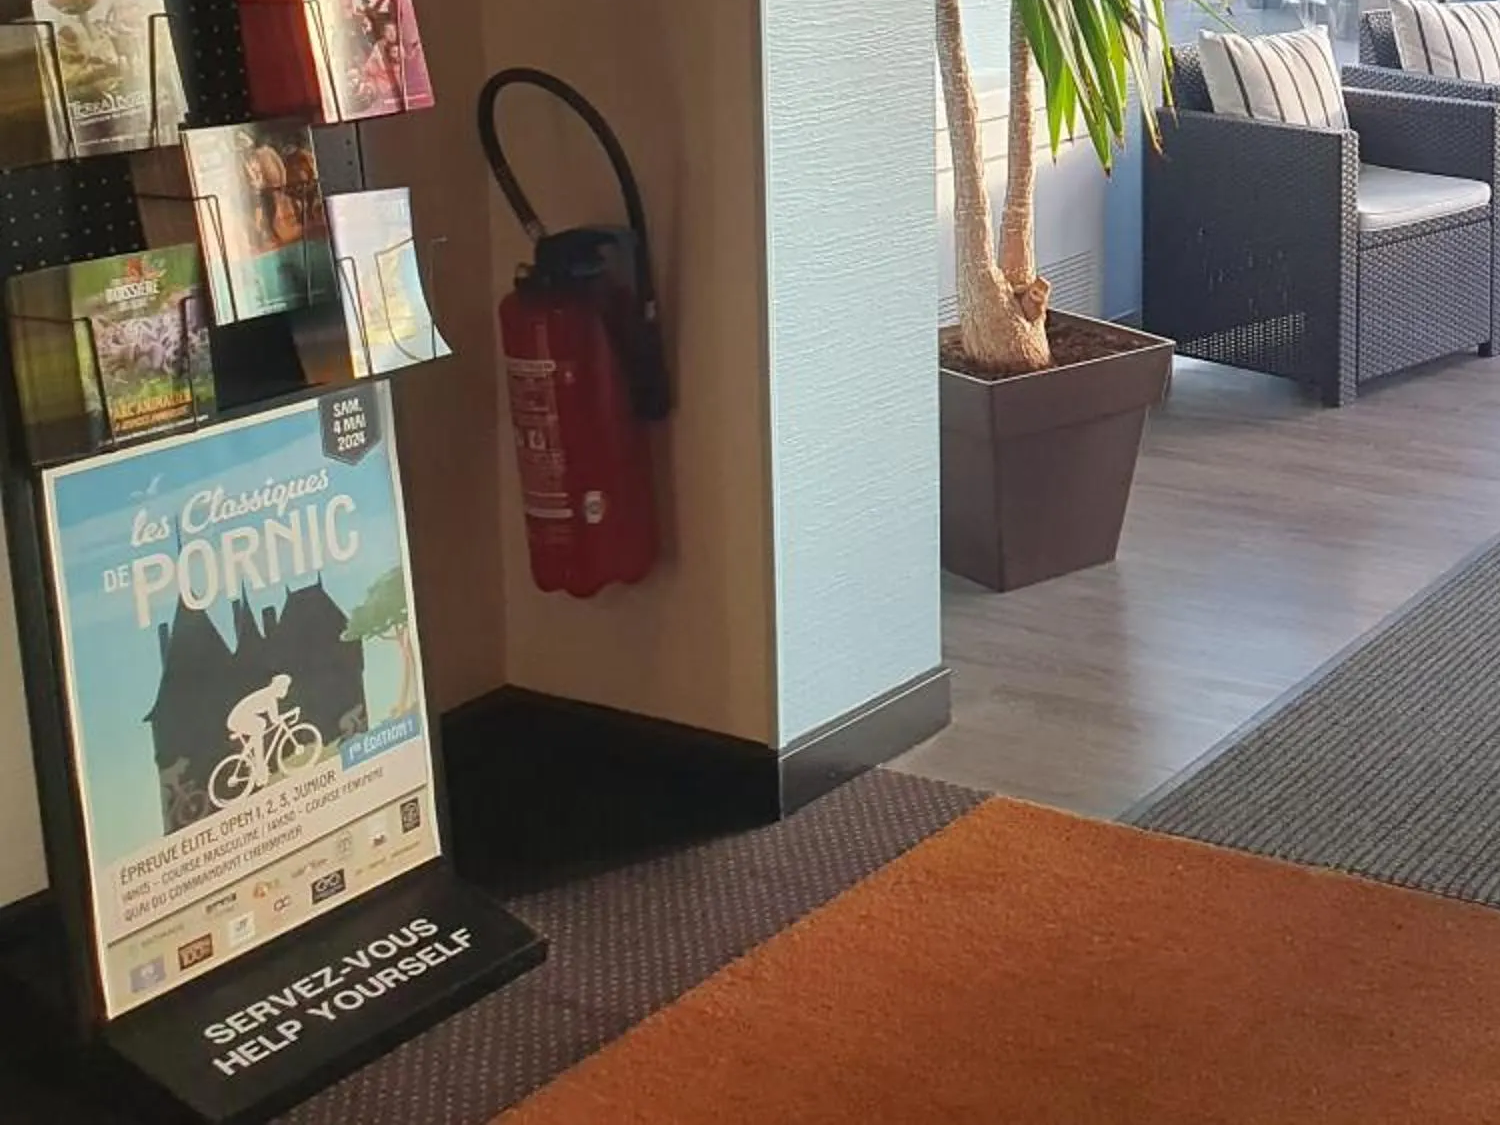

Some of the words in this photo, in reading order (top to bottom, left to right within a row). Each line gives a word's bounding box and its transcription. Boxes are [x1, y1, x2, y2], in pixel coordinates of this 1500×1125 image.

[333, 397, 363, 417] SAM.
[333, 420, 341, 435] 4
[343, 413, 367, 432] MAI
[337, 431, 366, 451] 2024
[181, 467, 329, 535] Classiques
[103, 564, 130, 593] DE
[130, 494, 360, 629] PORNIC
[119, 844, 179, 886] ÉPREUVE
[220, 809, 253, 836] OPEN
[293, 769, 337, 802] JUNIOR
[151, 892, 167, 910] DU
[203, 917, 438, 1044] SERVEZ-VOUS
[211, 1019, 303, 1076] HELP
[306, 927, 473, 1022] YOURSELF
